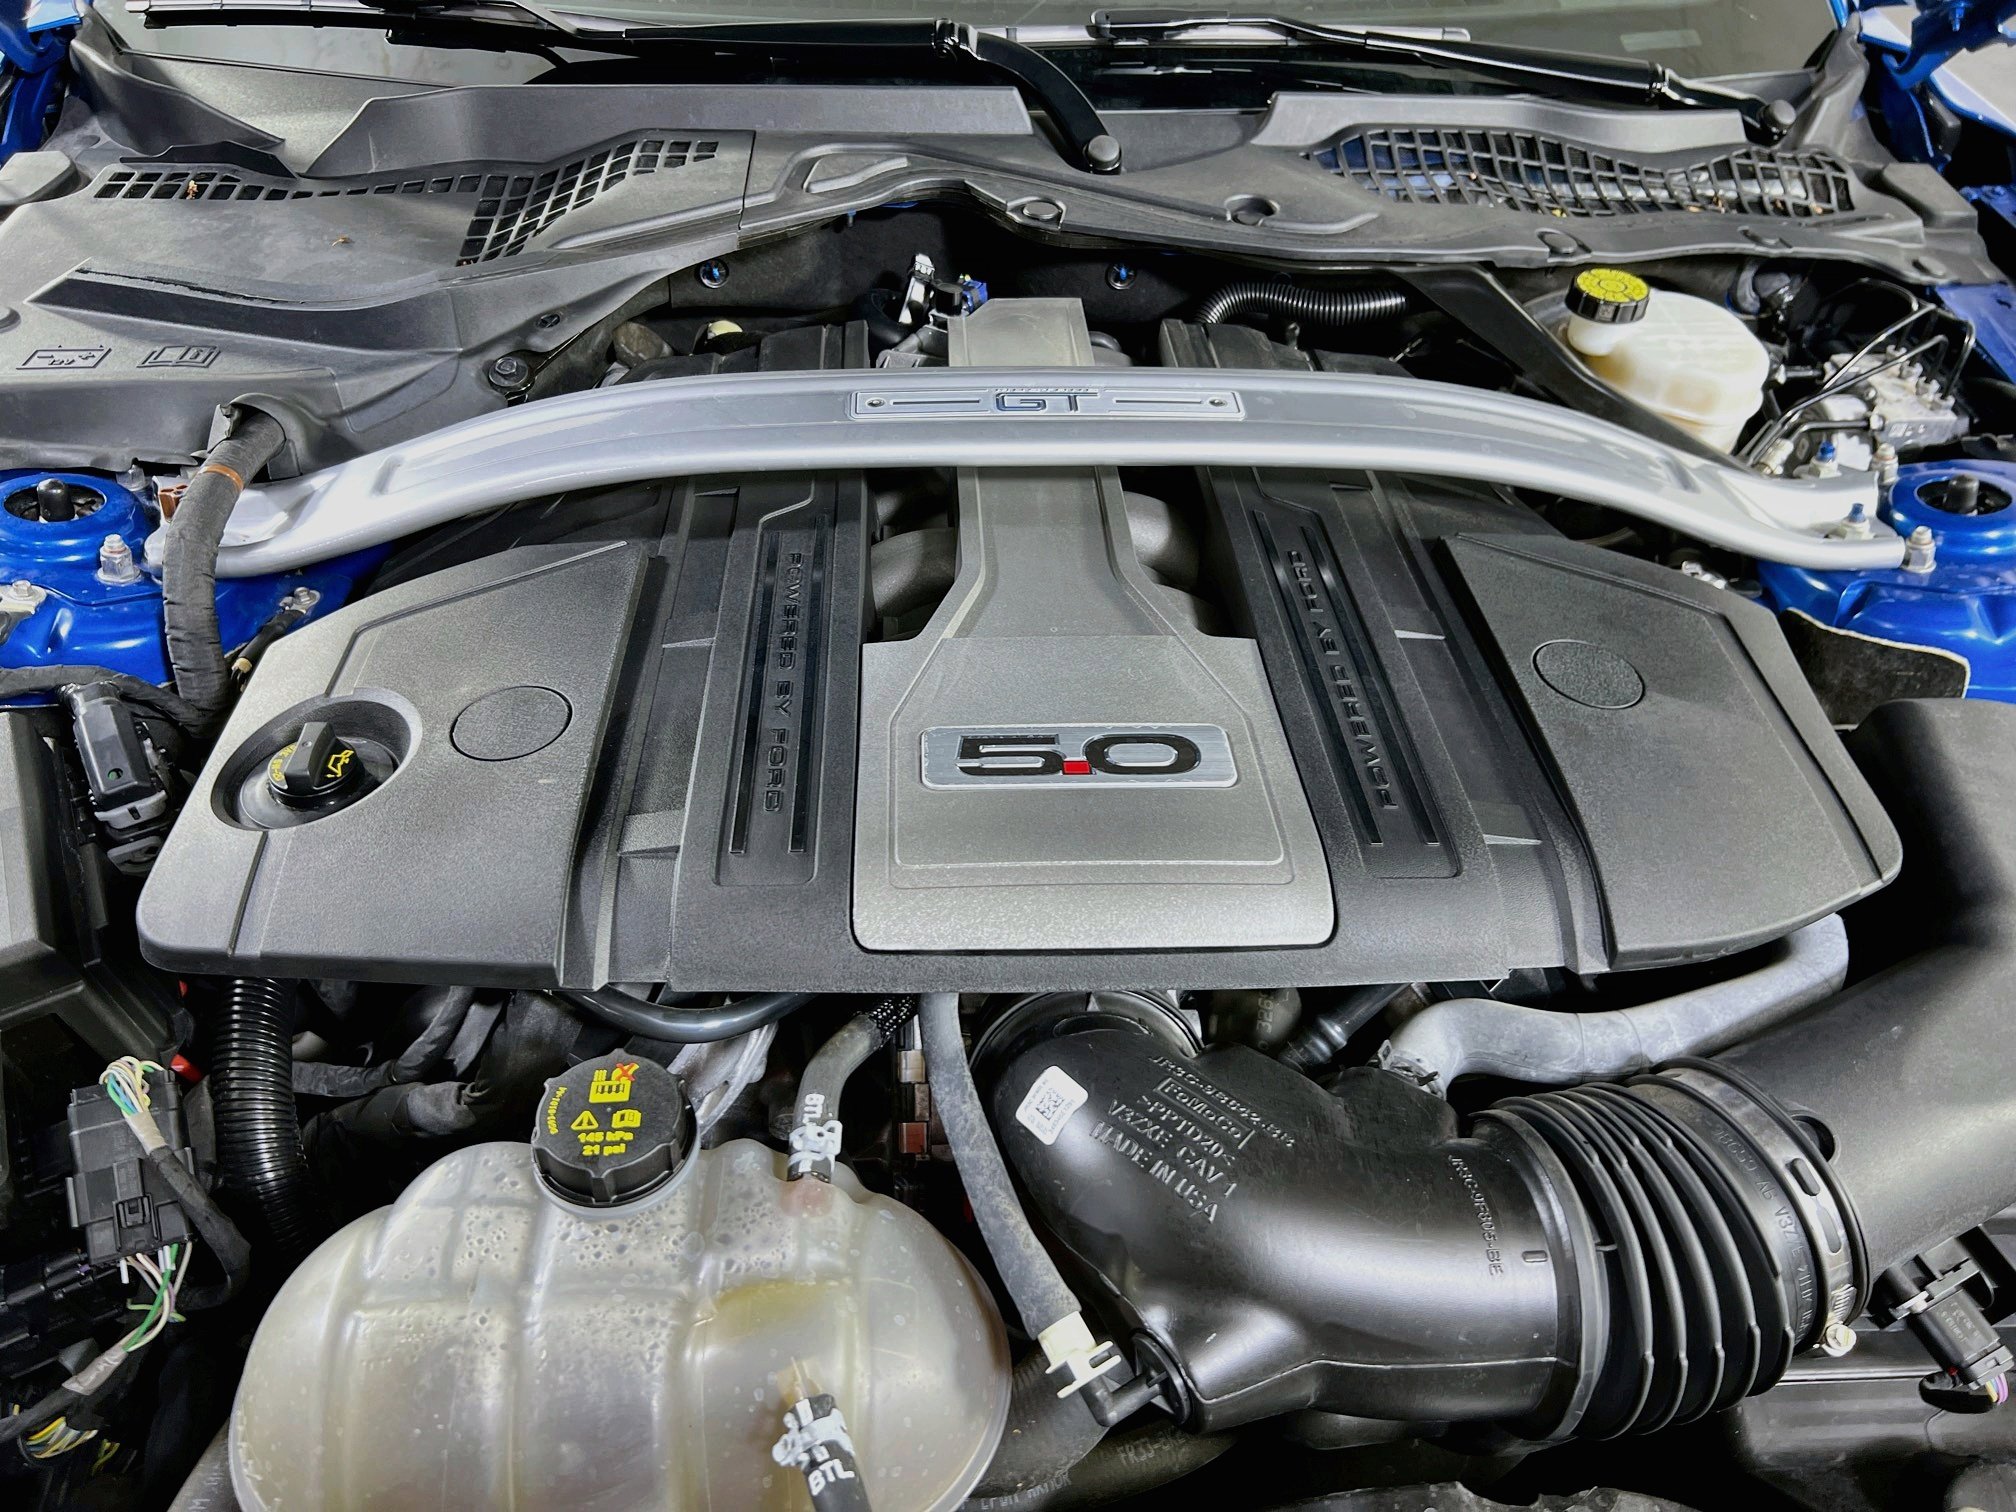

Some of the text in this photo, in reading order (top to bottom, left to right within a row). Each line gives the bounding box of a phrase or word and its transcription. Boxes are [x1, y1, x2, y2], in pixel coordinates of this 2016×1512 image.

[995, 391, 1100, 413] GT
[762, 551, 804, 813] POWERED BY FORD
[1286, 550, 1399, 810] POWERED BY FORD
[955, 733, 1202, 776] 5.0
[1164, 1082, 1242, 1139] FoMoCo
[577, 1130, 604, 1143] 145
[582, 1143, 600, 1156] 21
[1089, 1121, 1153, 1169] MADE
[1149, 1159, 1177, 1185] IN
[1174, 1178, 1218, 1225] USA
[1176, 1146, 1224, 1184] CAV
[807, 1458, 856, 1496] BTL
